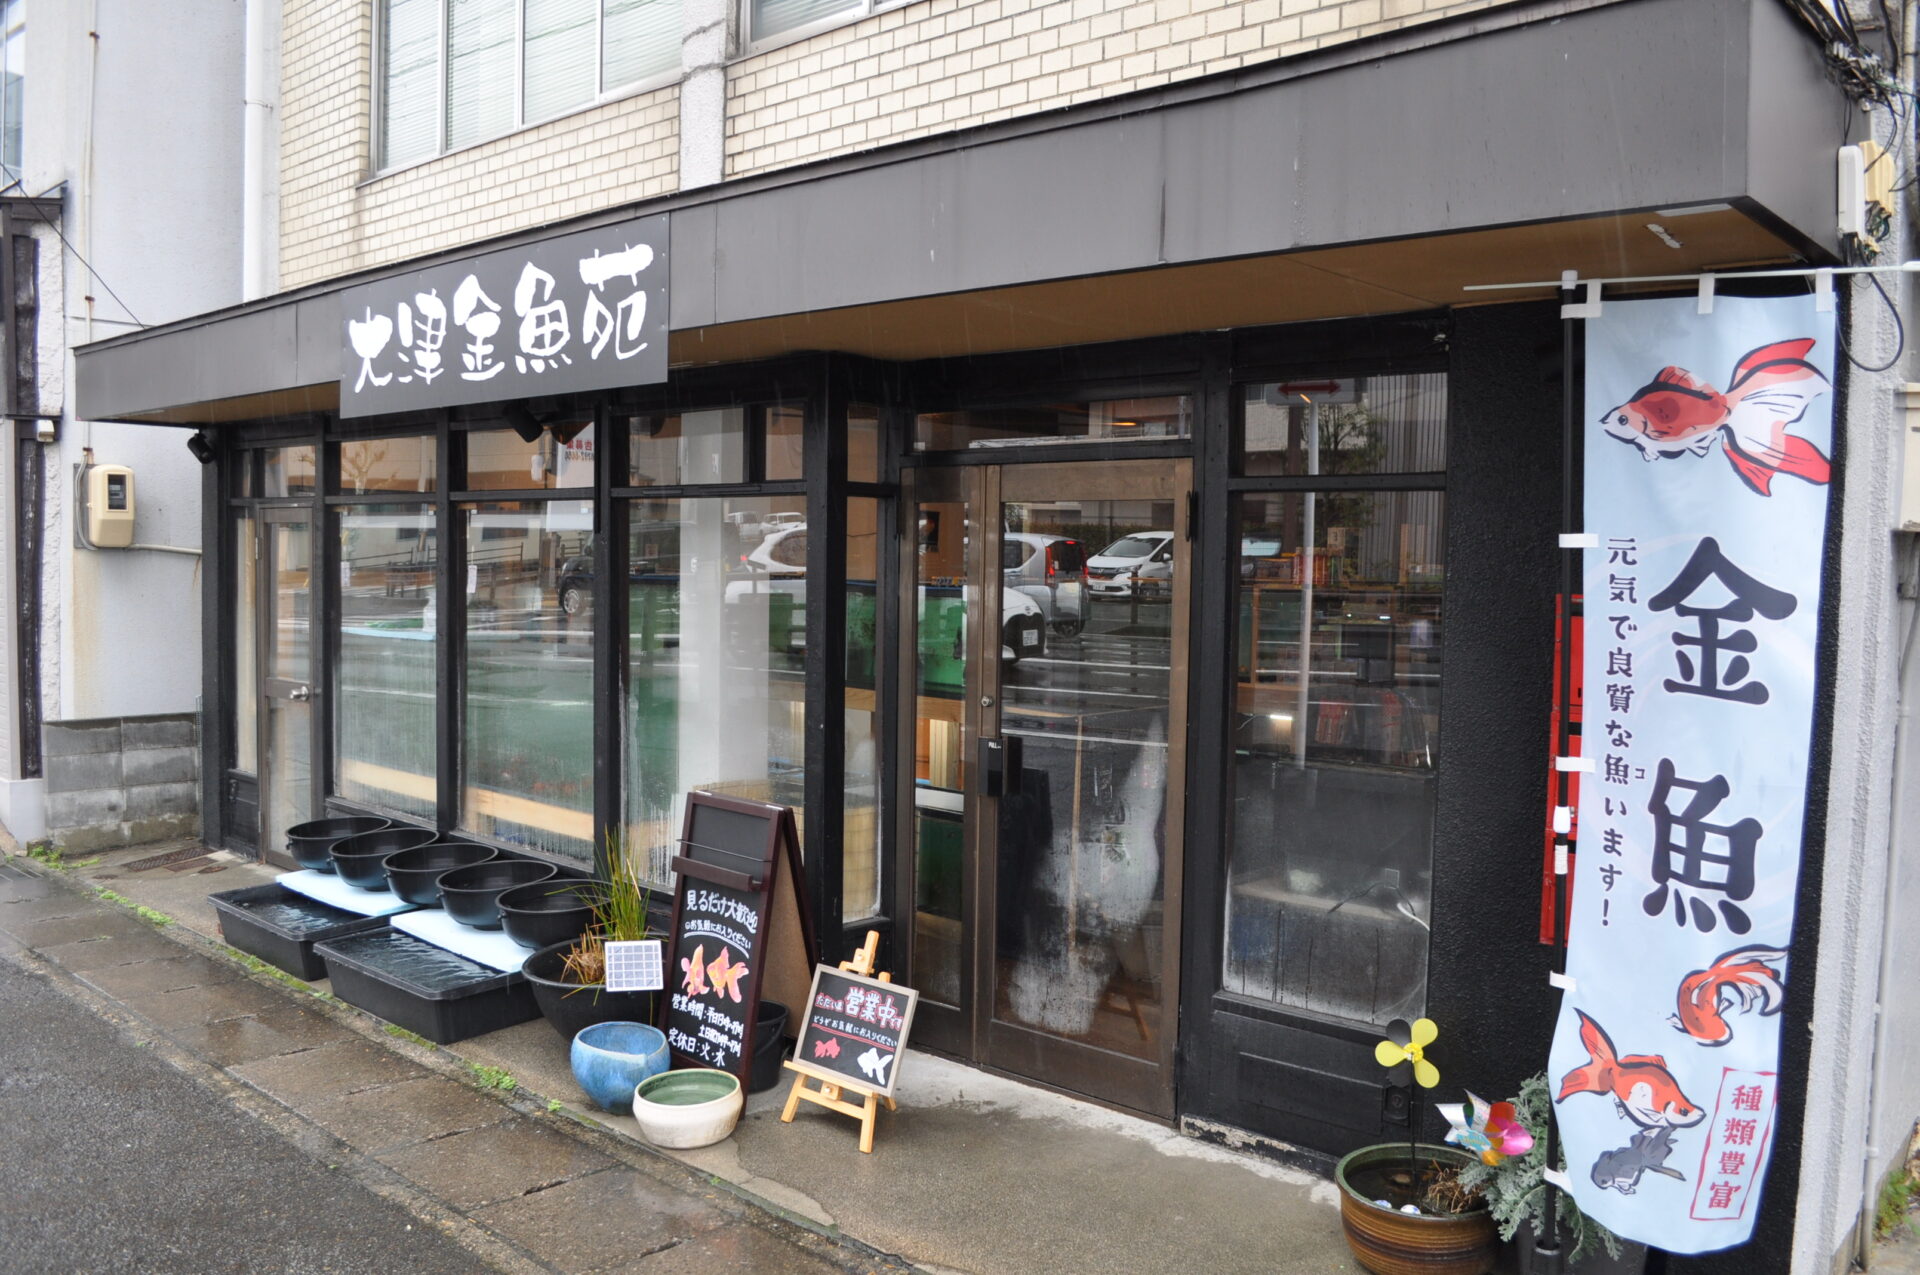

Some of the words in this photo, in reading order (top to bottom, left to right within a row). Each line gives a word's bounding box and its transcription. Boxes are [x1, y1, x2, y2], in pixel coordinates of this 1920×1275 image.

[1641, 536, 1798, 935] 金魚
[686, 889, 759, 934] 見るだけ大歓迎
[1708, 1084, 1764, 1210] 種類豊富
